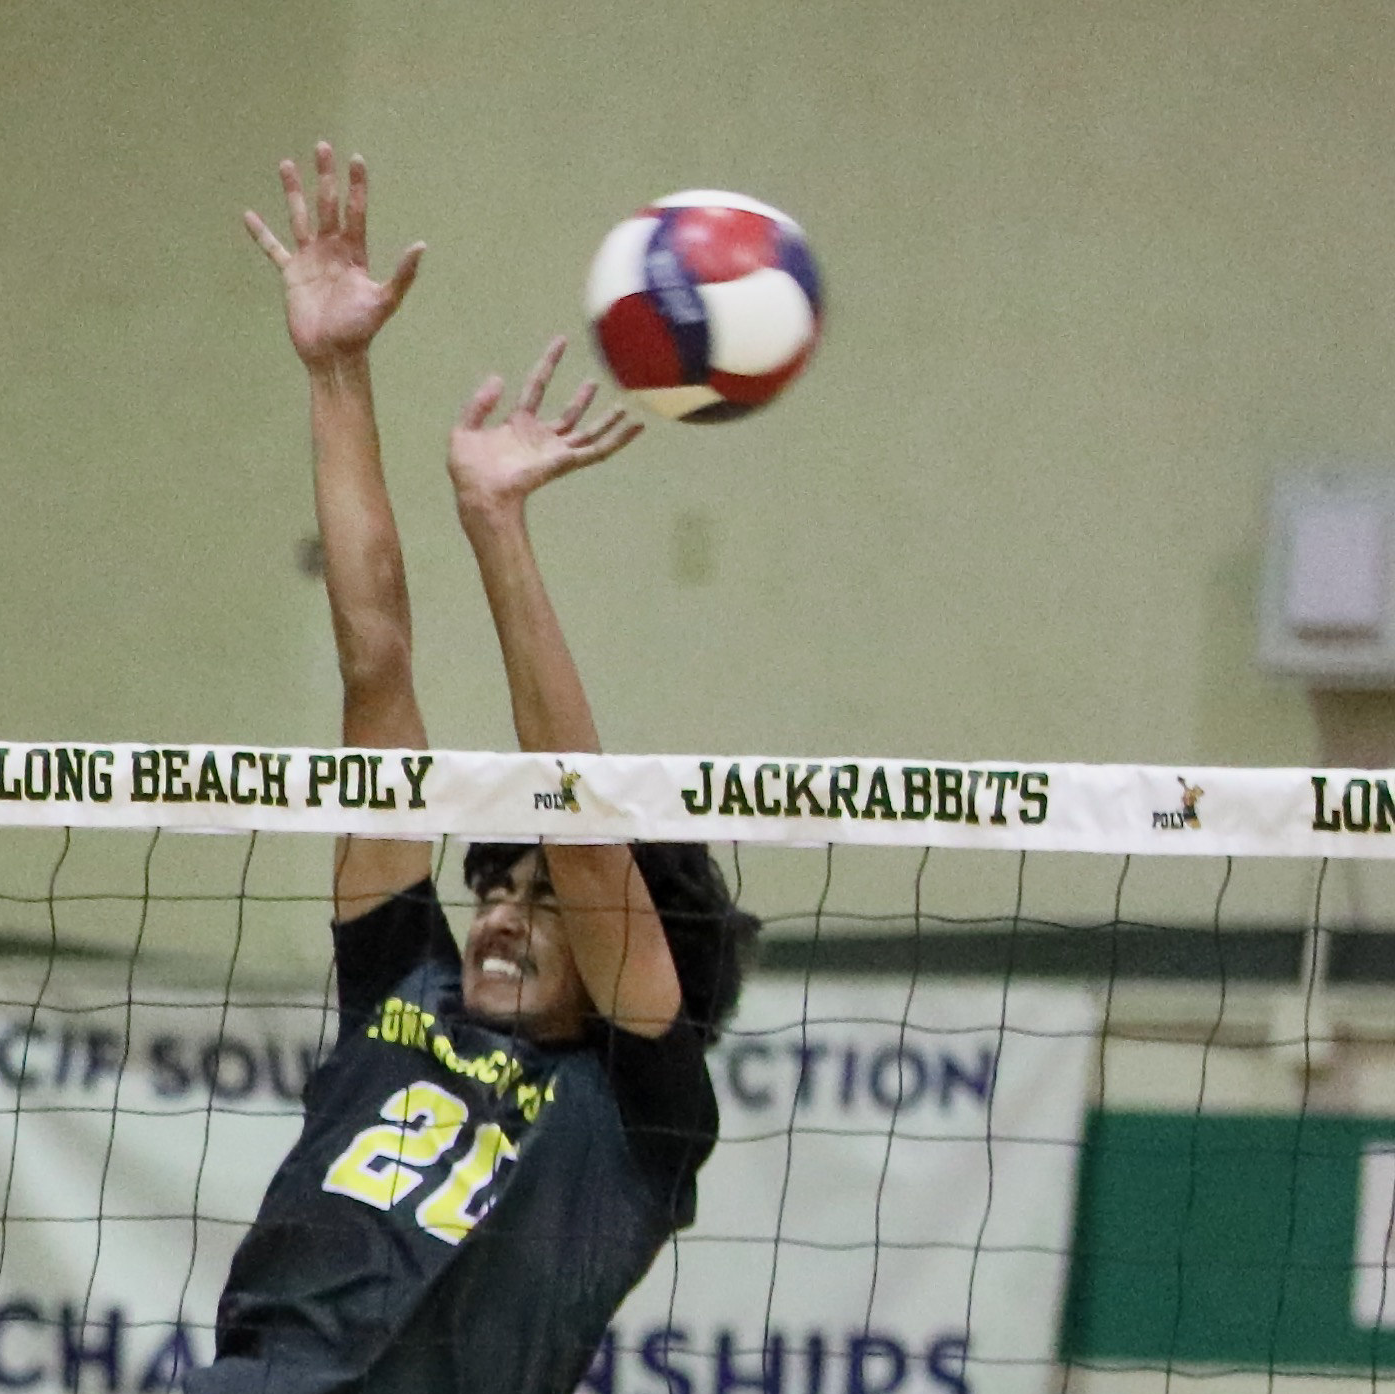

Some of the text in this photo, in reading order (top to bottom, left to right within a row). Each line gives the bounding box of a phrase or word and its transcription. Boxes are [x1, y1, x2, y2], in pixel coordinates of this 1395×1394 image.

[130, 750, 291, 808] BEACH
[305, 754, 434, 810] POLY
[680, 762, 1049, 825] JACKRABBITS
